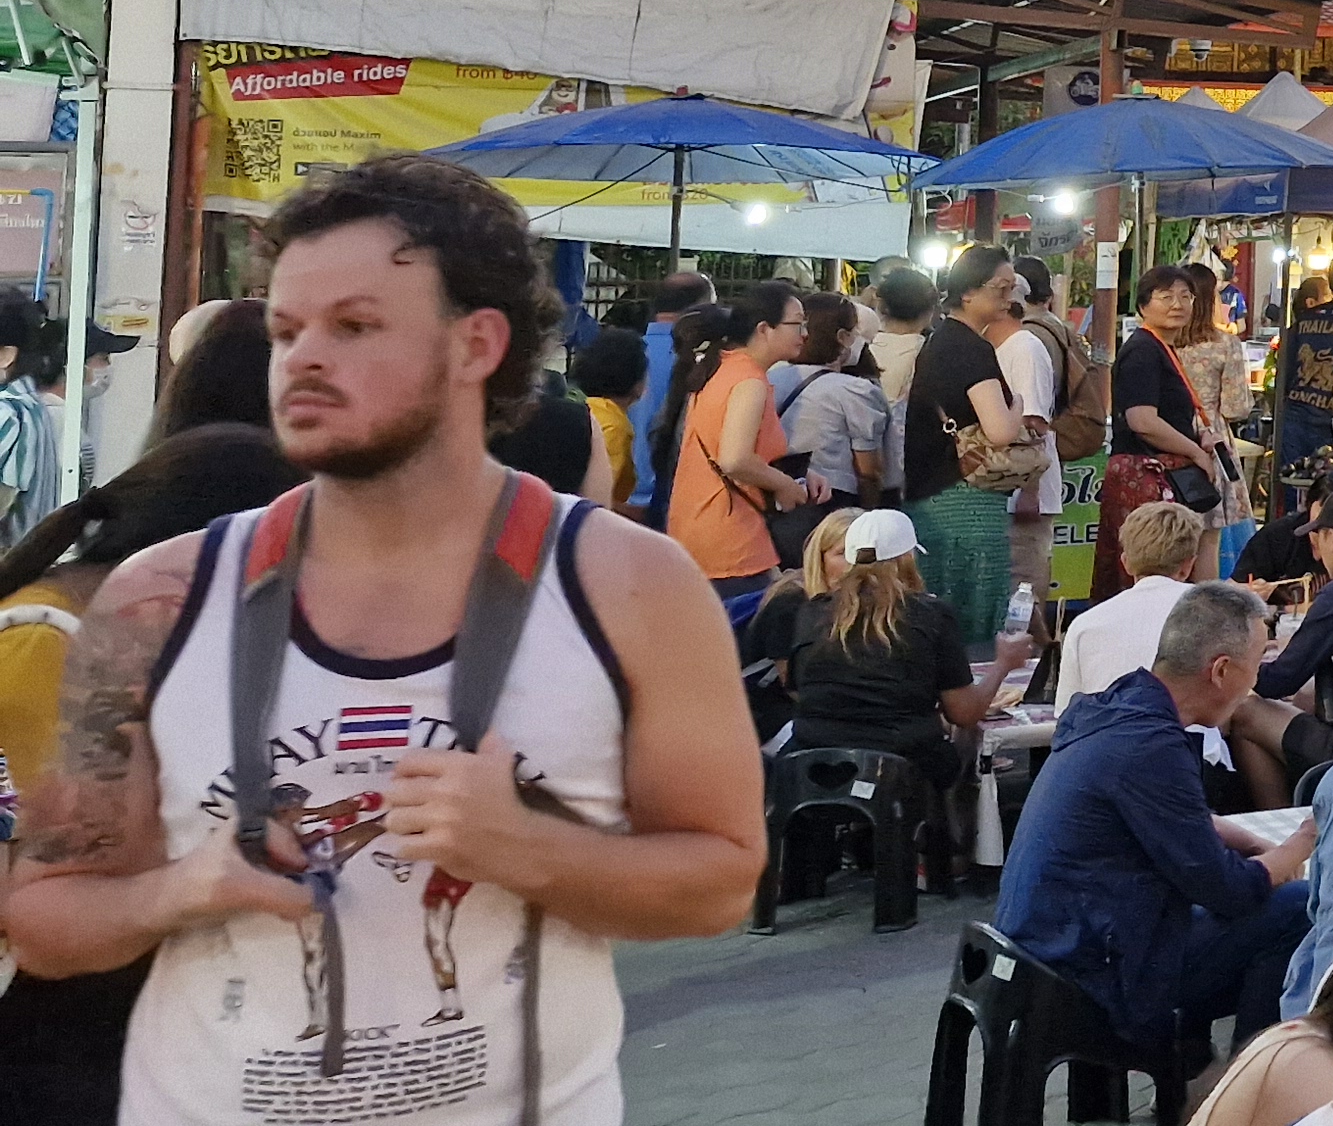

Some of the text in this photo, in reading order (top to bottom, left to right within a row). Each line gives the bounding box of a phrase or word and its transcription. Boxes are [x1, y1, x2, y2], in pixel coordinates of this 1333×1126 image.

[456, 64, 496, 79] from
[230, 63, 407, 96] Affordable rides
[340, 129, 382, 139] Maxim
